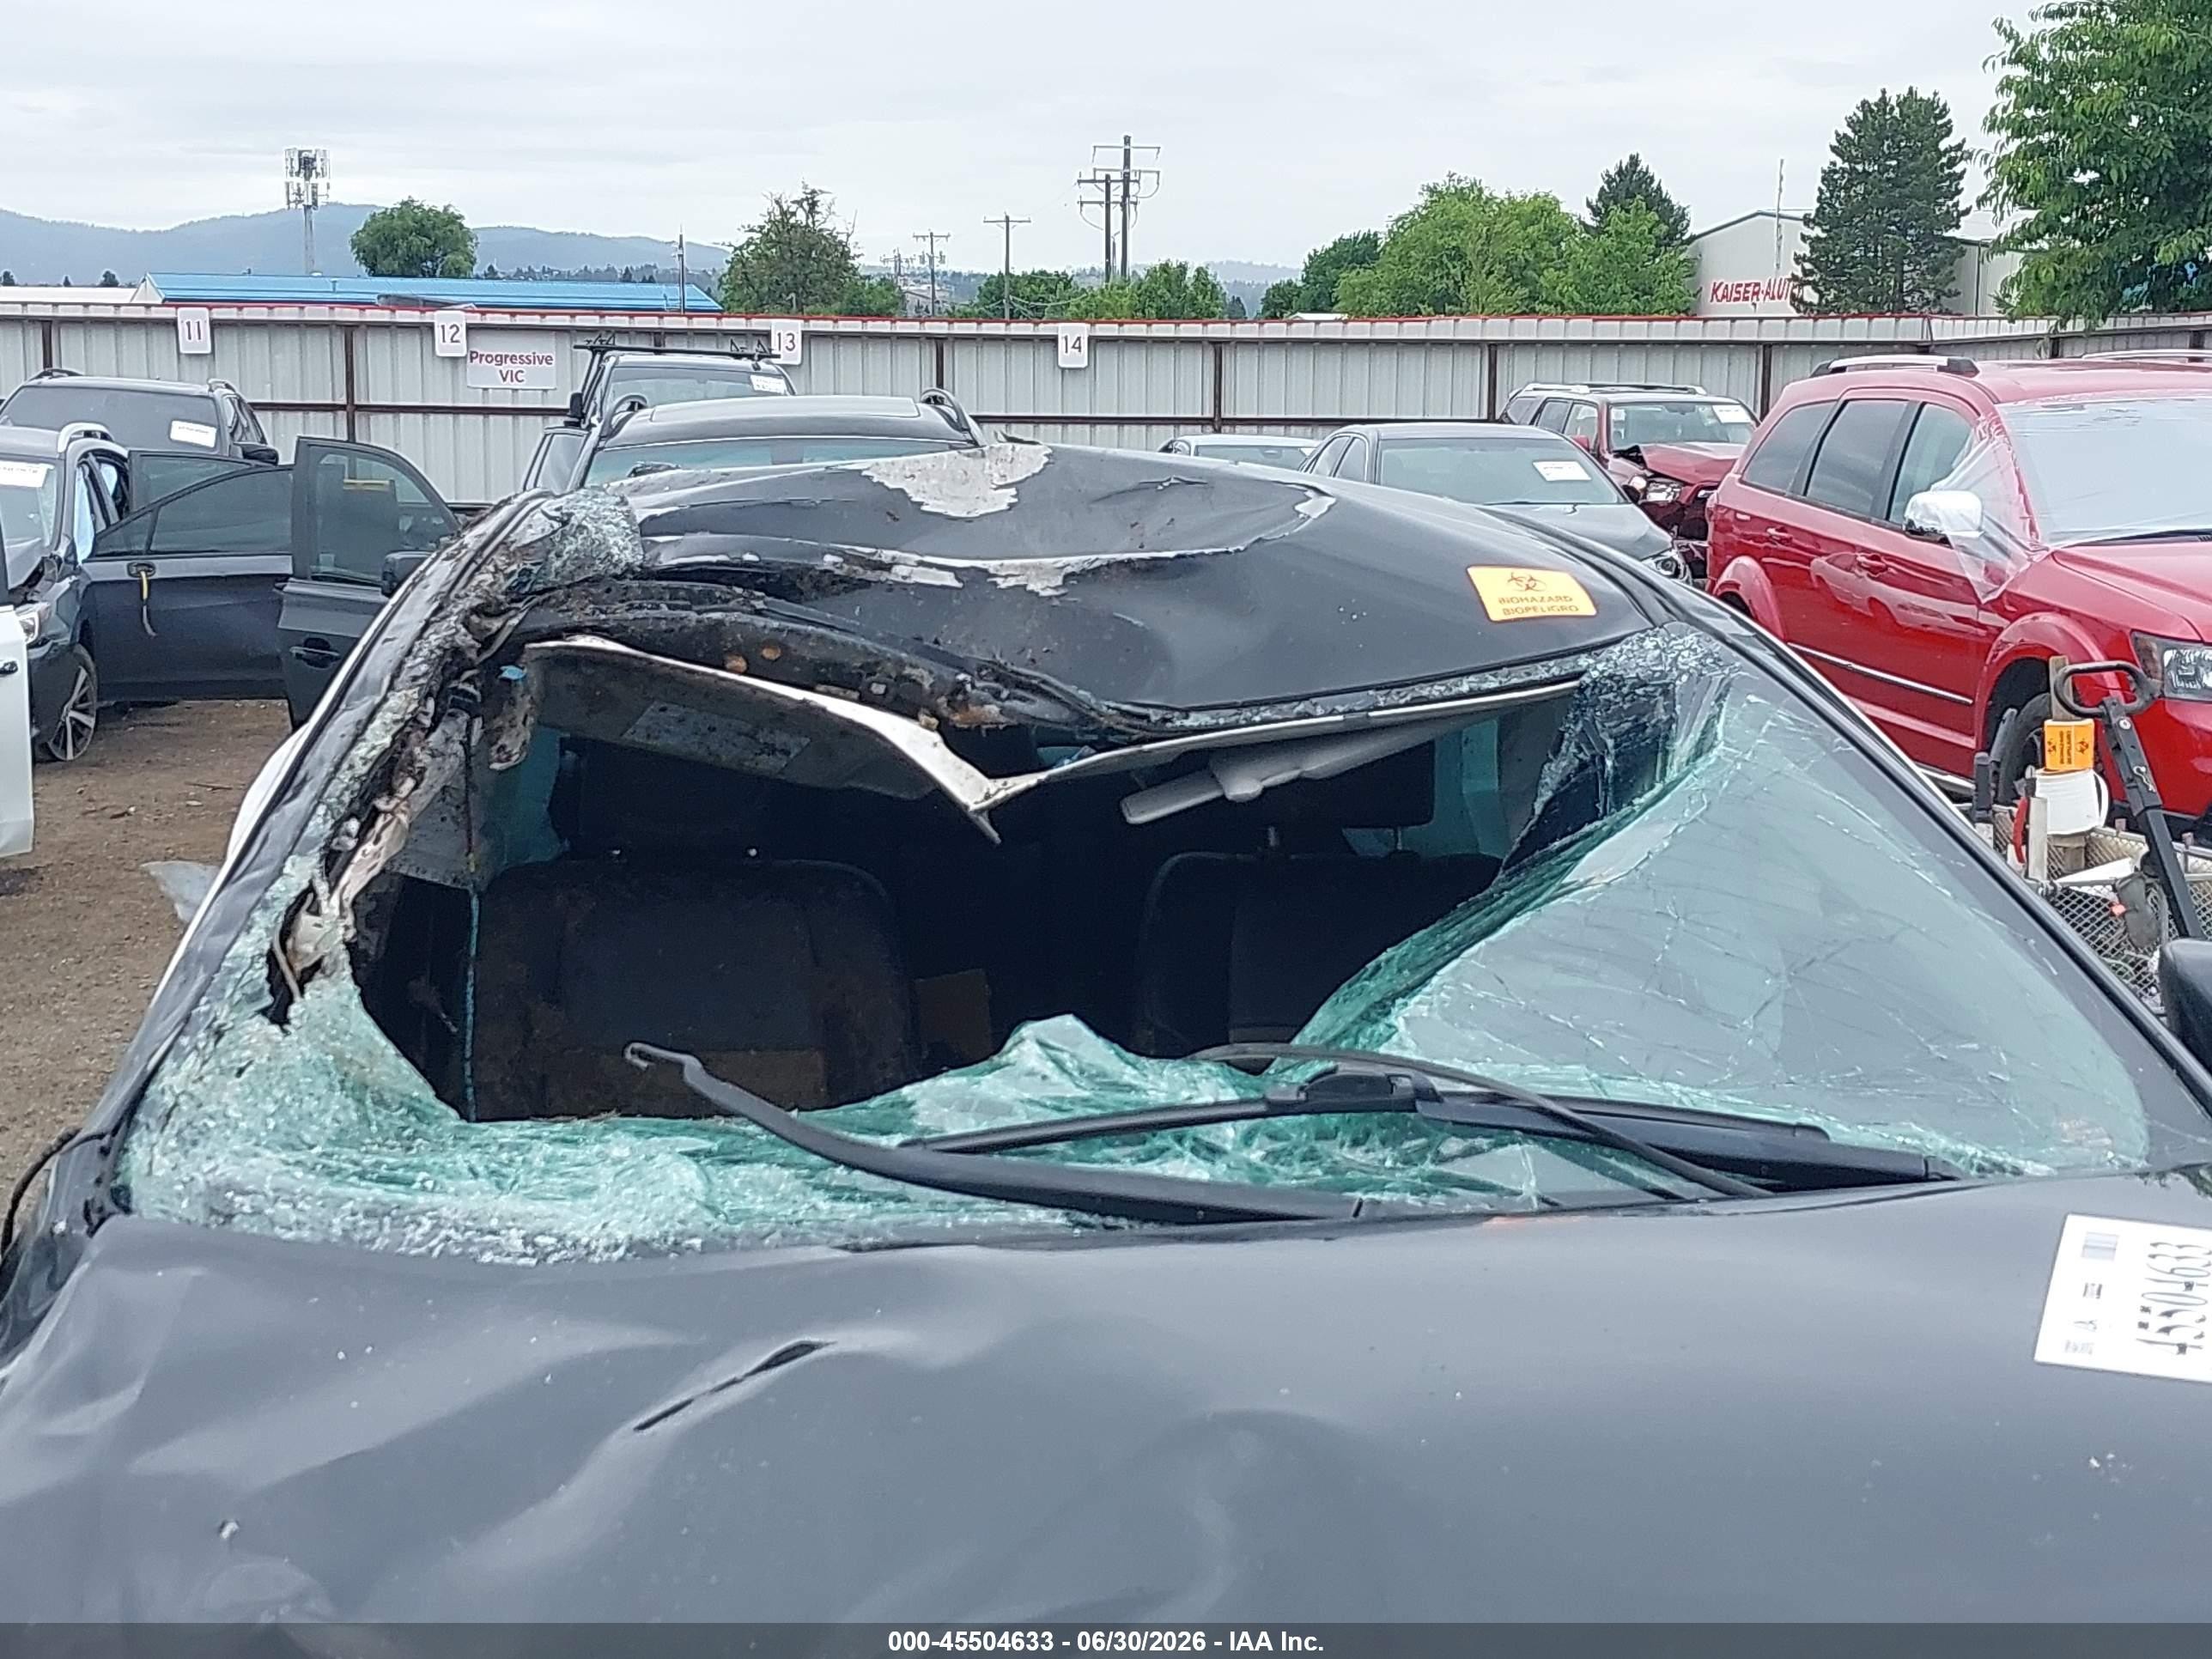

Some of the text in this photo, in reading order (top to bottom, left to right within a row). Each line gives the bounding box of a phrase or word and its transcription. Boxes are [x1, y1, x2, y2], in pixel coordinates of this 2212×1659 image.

[185, 319, 202, 341] 11
[441, 324, 461, 343] 12
[777, 331, 796, 352] 13
[1064, 335, 1082, 354] 14
[469, 350, 554, 366] Progressive
[499, 369, 525, 383] VIC
[1498, 595, 1573, 605] BIOHAZARD
[1502, 605, 1579, 616] BIOPELIGRO
